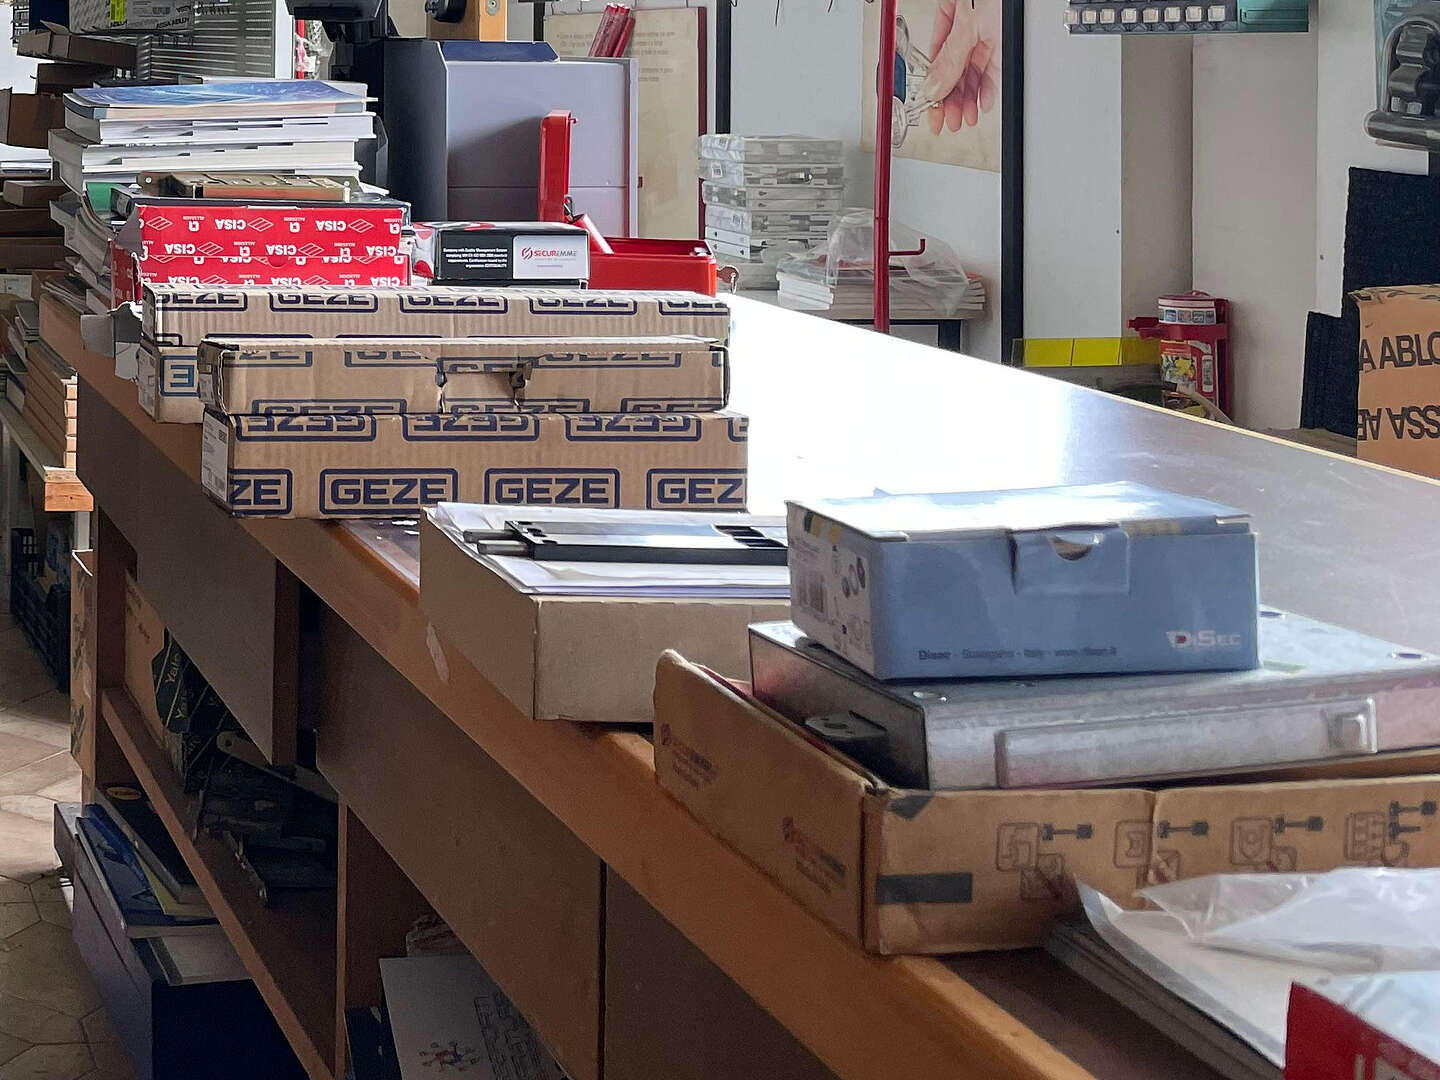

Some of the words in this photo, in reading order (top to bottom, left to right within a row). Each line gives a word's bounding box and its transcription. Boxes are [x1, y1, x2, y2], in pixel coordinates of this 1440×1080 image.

[214, 219, 246, 230] CISA
[315, 220, 347, 232] CISA
[164, 242, 196, 254] CISA
[265, 244, 297, 256] CISA
[365, 245, 397, 257] CISA
[534, 249, 577, 257] SECUREMME
[168, 276, 201, 285] CISA
[270, 276, 302, 286] CISA
[370, 276, 401, 286] CISA
[331, 478, 447, 505] GEZE
[495, 478, 610, 505] GEZE
